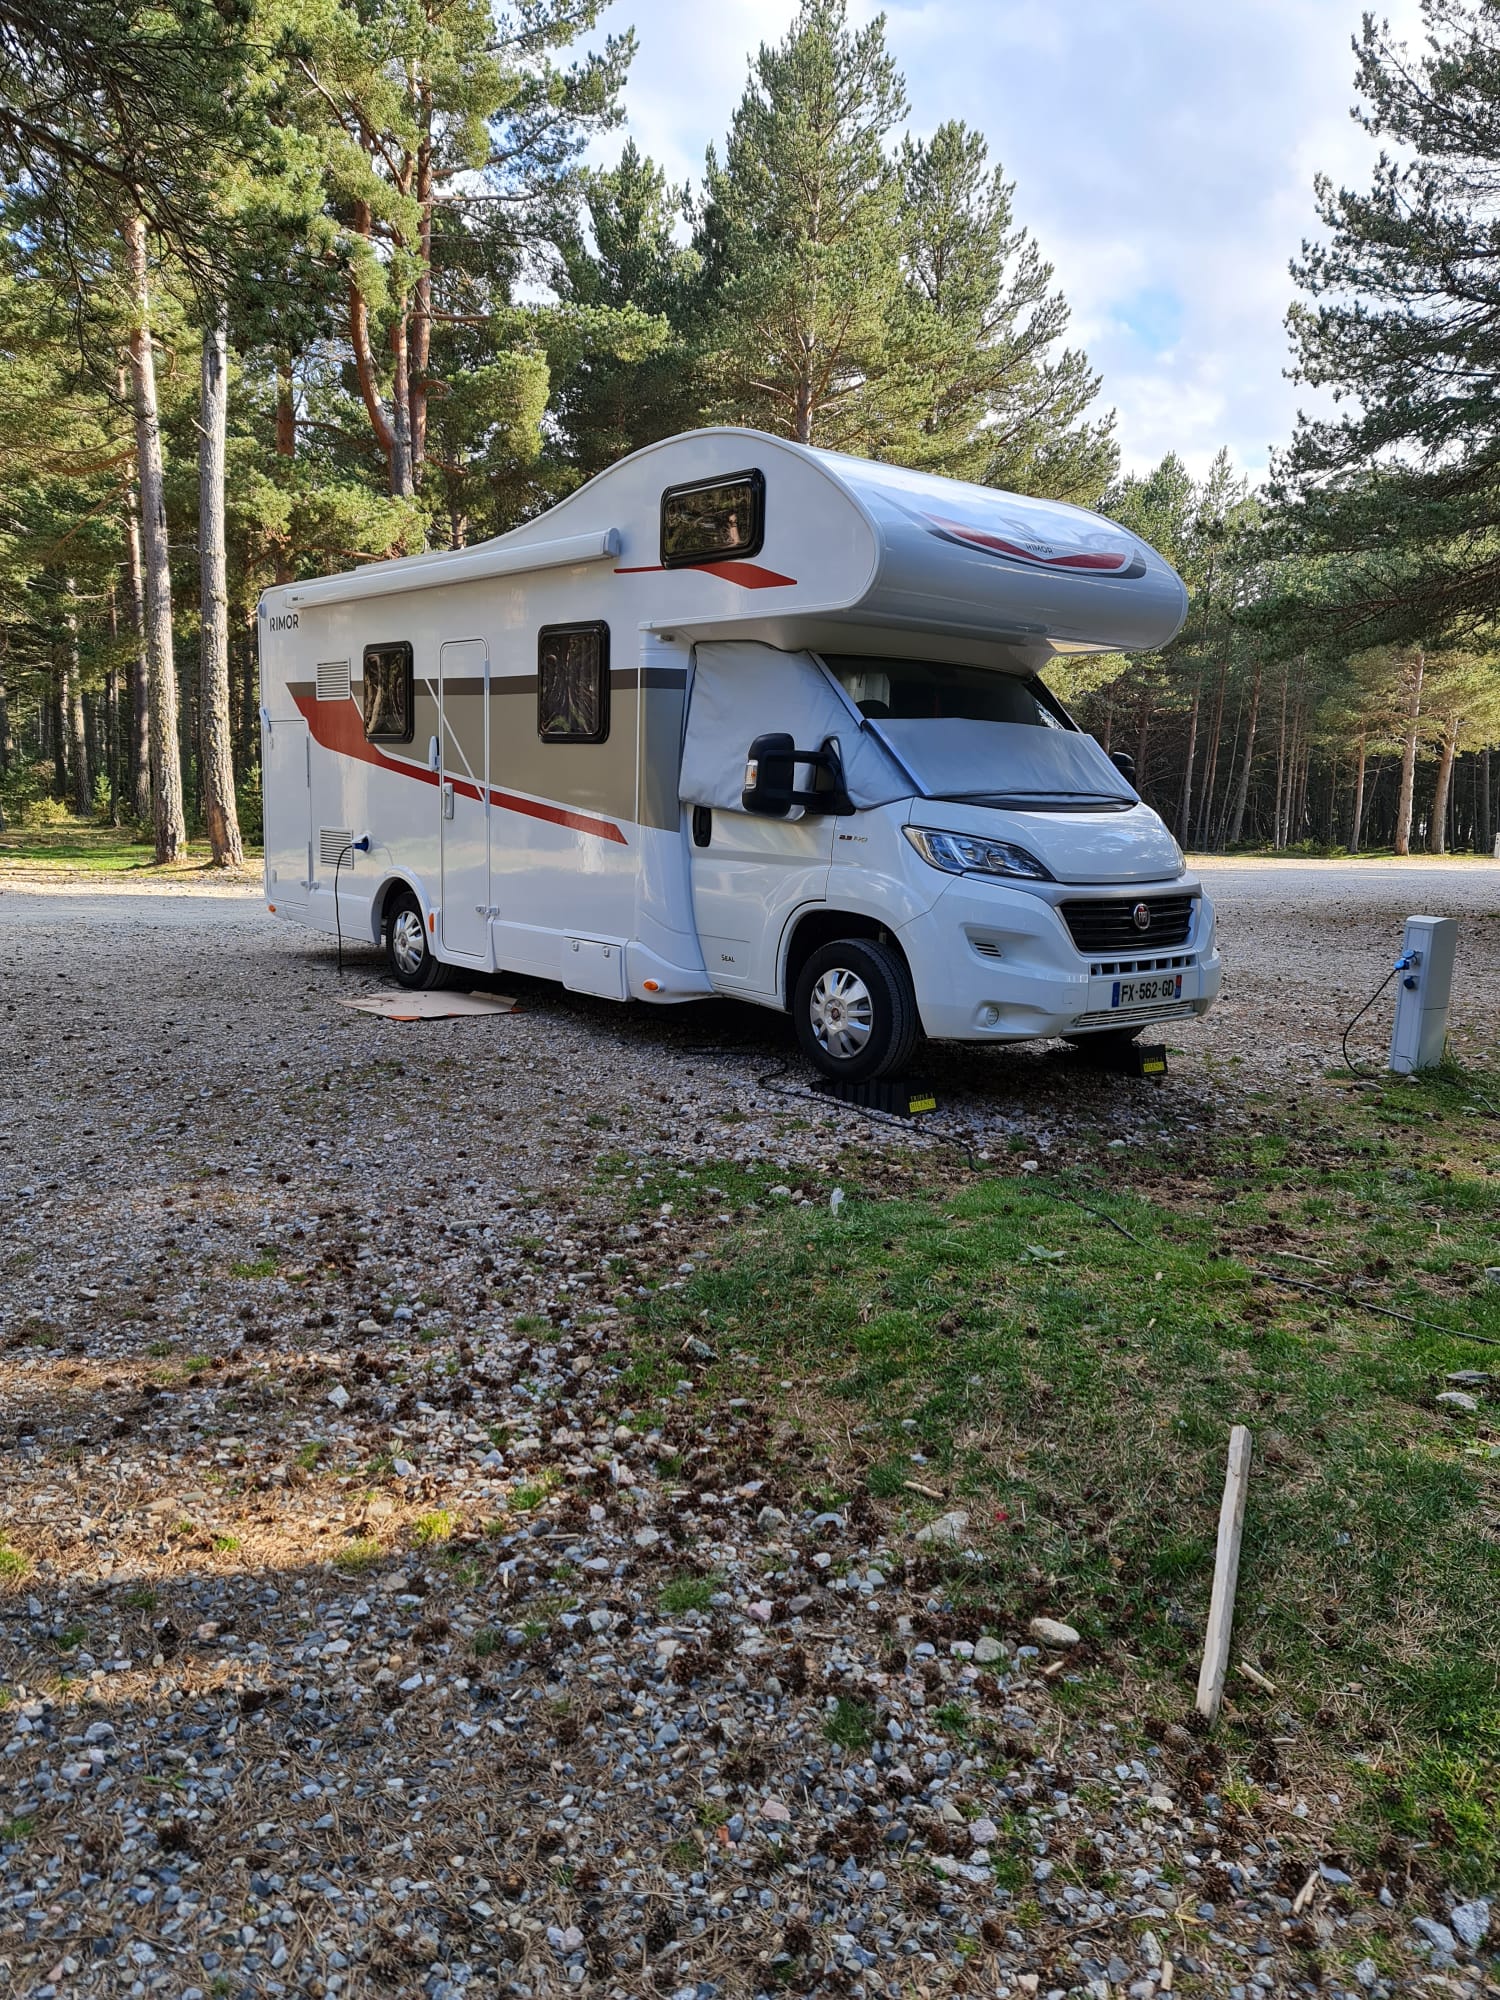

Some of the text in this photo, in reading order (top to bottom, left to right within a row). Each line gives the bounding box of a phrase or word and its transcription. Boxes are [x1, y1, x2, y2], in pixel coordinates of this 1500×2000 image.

[1025, 542, 1054, 555] RIMOR
[269, 614, 299, 632] RIMOR
[721, 954, 735, 962] SEAL
[1121, 979, 1174, 1002] FX-562-GD
